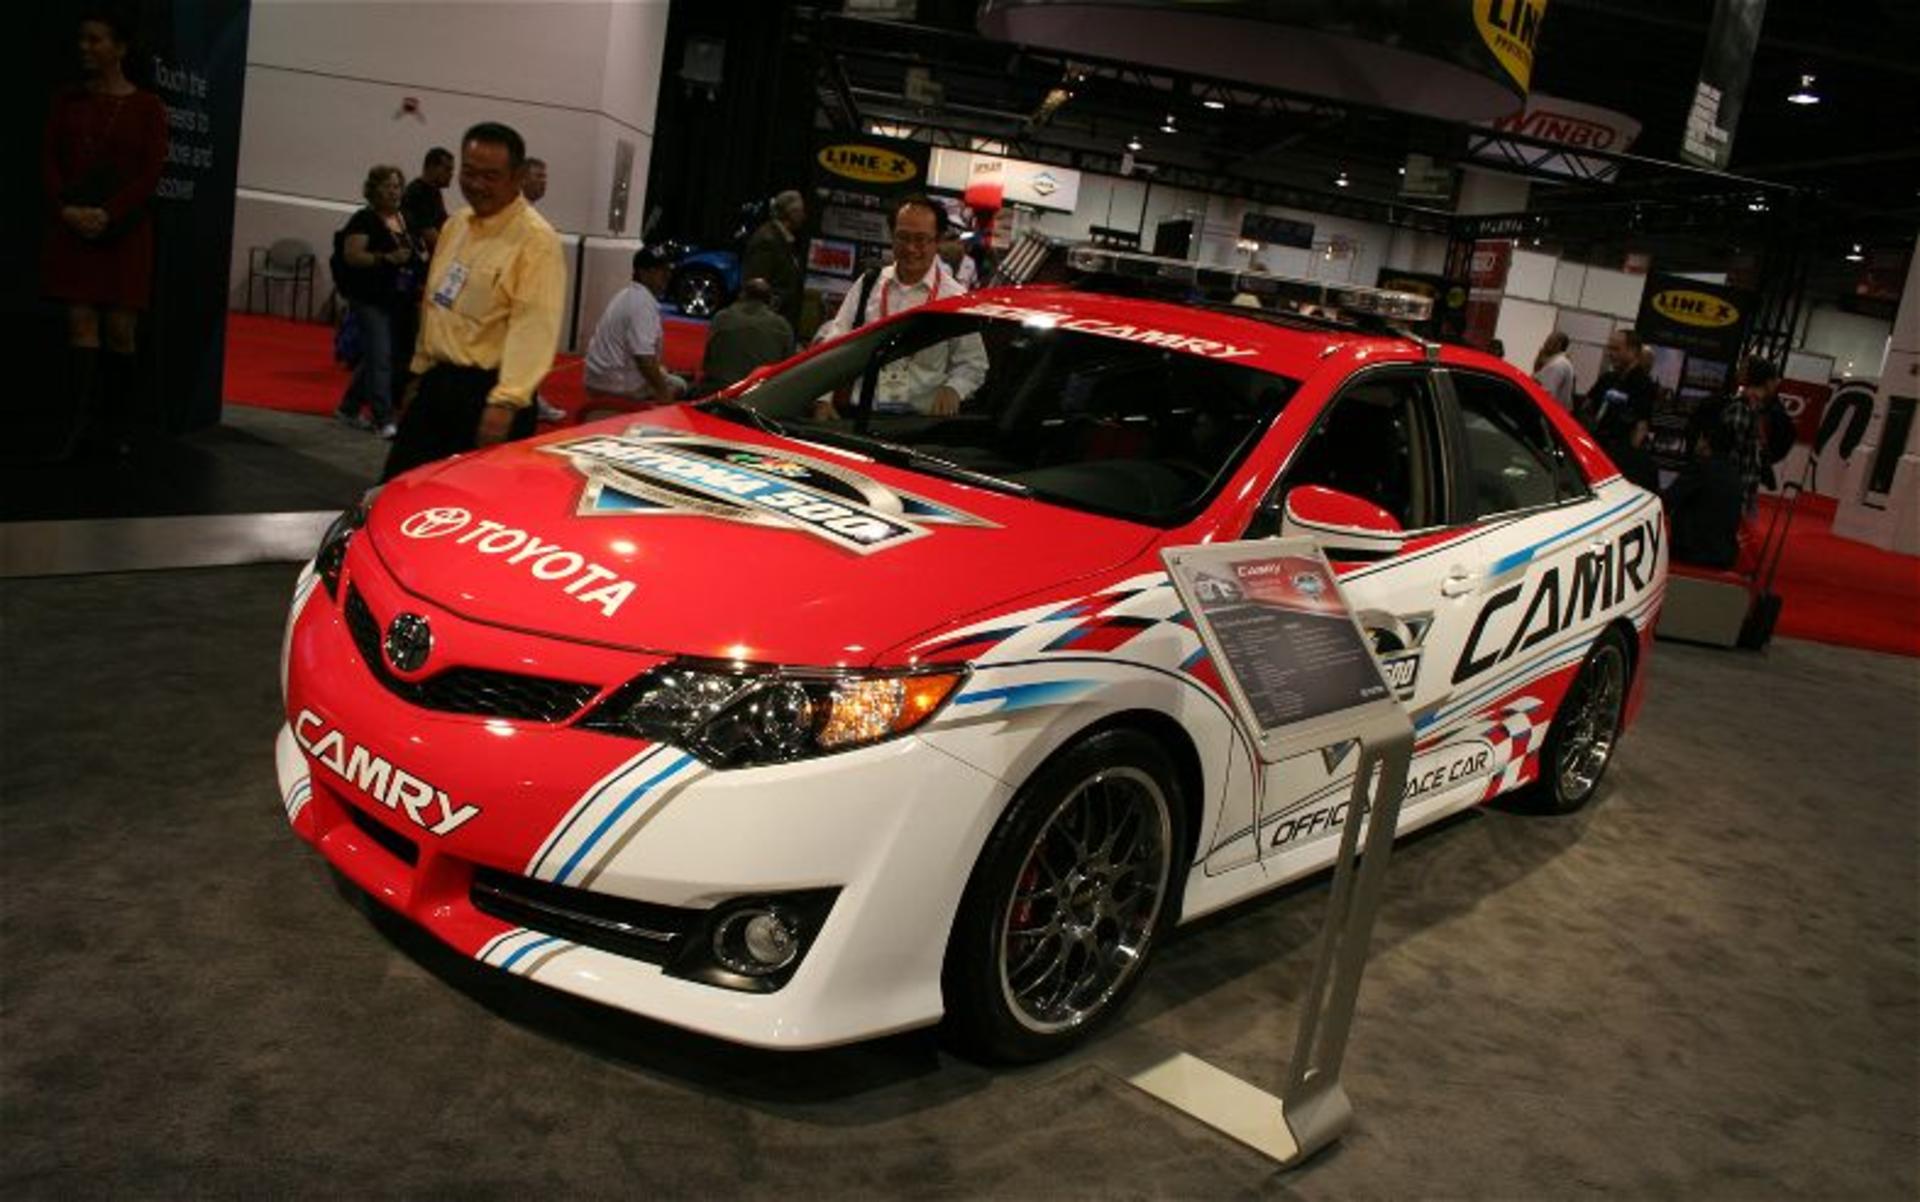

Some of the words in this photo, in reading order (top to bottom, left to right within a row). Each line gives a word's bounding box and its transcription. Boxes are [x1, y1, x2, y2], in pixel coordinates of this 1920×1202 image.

[1060, 317, 1260, 360] CAMRY
[752, 487, 895, 542] 500
[456, 519, 638, 617] TOYOTA
[1451, 510, 1663, 686] CAMRY
[294, 708, 481, 837] CAMRY
[1271, 799, 1369, 847] OFFIC
[1403, 765, 1447, 799] ACE
[1448, 750, 1489, 782] CAR
